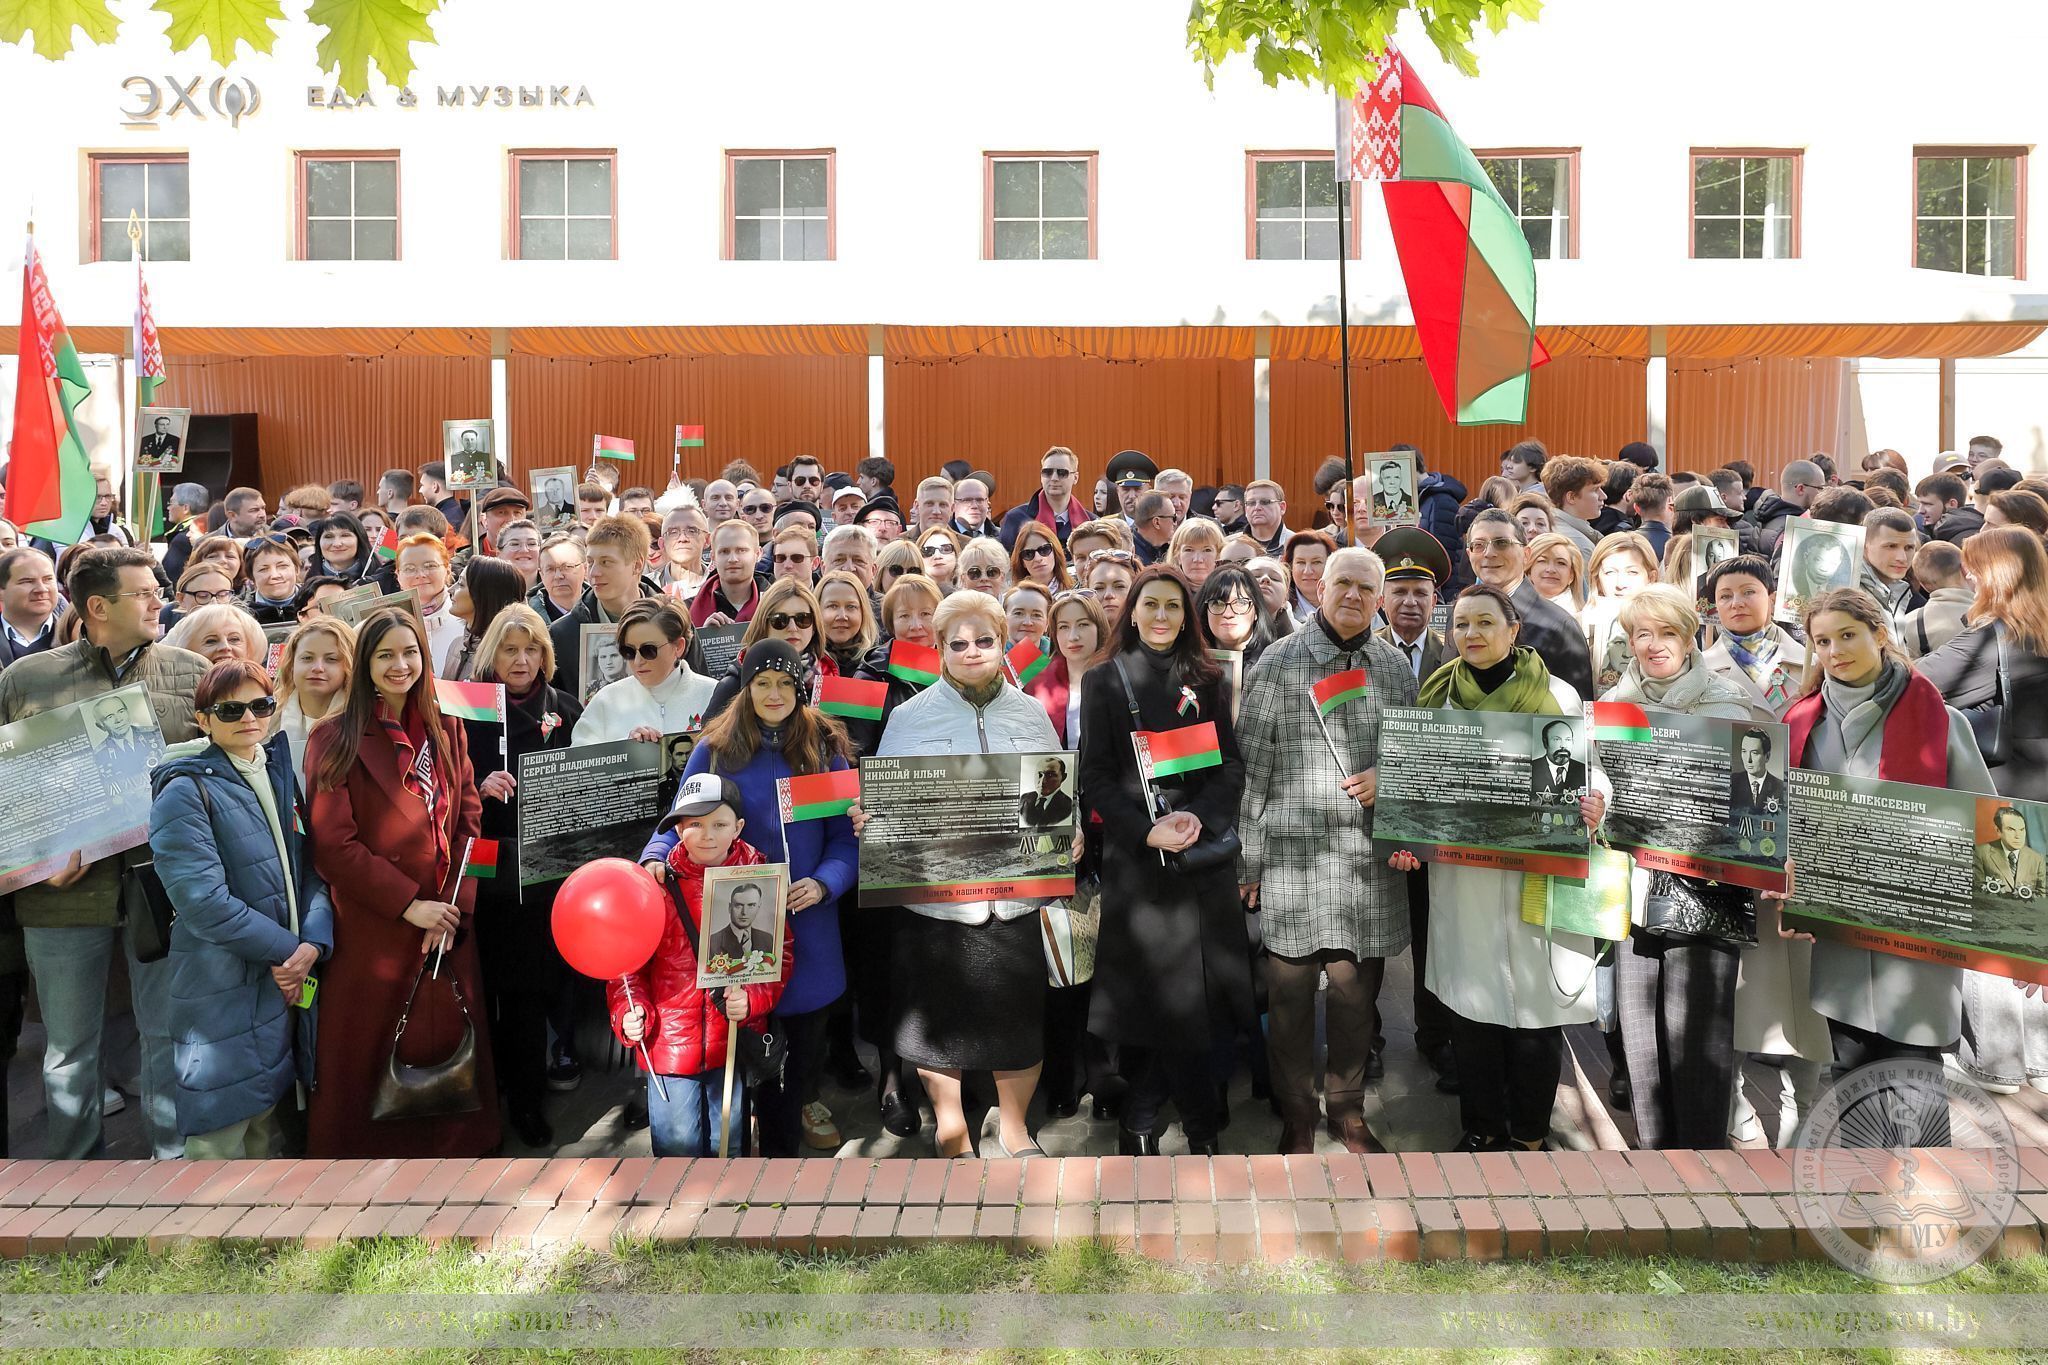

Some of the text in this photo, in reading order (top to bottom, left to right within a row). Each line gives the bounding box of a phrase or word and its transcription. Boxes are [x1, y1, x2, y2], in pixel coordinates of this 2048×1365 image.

[307, 85, 596, 109] ЕДА & МУЗЫКА
[1383, 708, 1433, 720] ШЕВЛЯКОВ
[1382, 720, 1483, 735] ЛЕОНИД ВАСИЛЬЕВИЧ
[523, 751, 566, 766] ЛЕШУКОВ
[523, 753, 628, 777] СЕРГЕЙ ВЛАДИМИРОВИЧ
[864, 759, 900, 769] ШВАРЦ
[864, 769, 946, 780] НИКОЛАЙ ИЛЬИЧ
[1789, 771, 1830, 785] ОБУХОВ
[1789, 784, 1927, 813] ГЕННАДИЙ АЛЕКСЕЕВИЧ
[1433, 849, 1463, 859] Память
[1465, 852, 1493, 862] нашим
[1644, 852, 1670, 865] Память
[1671, 858, 1697, 869] нашим
[922, 886, 1014, 898] Память нашим героям
[1855, 931, 1967, 962] Память нашим героям
